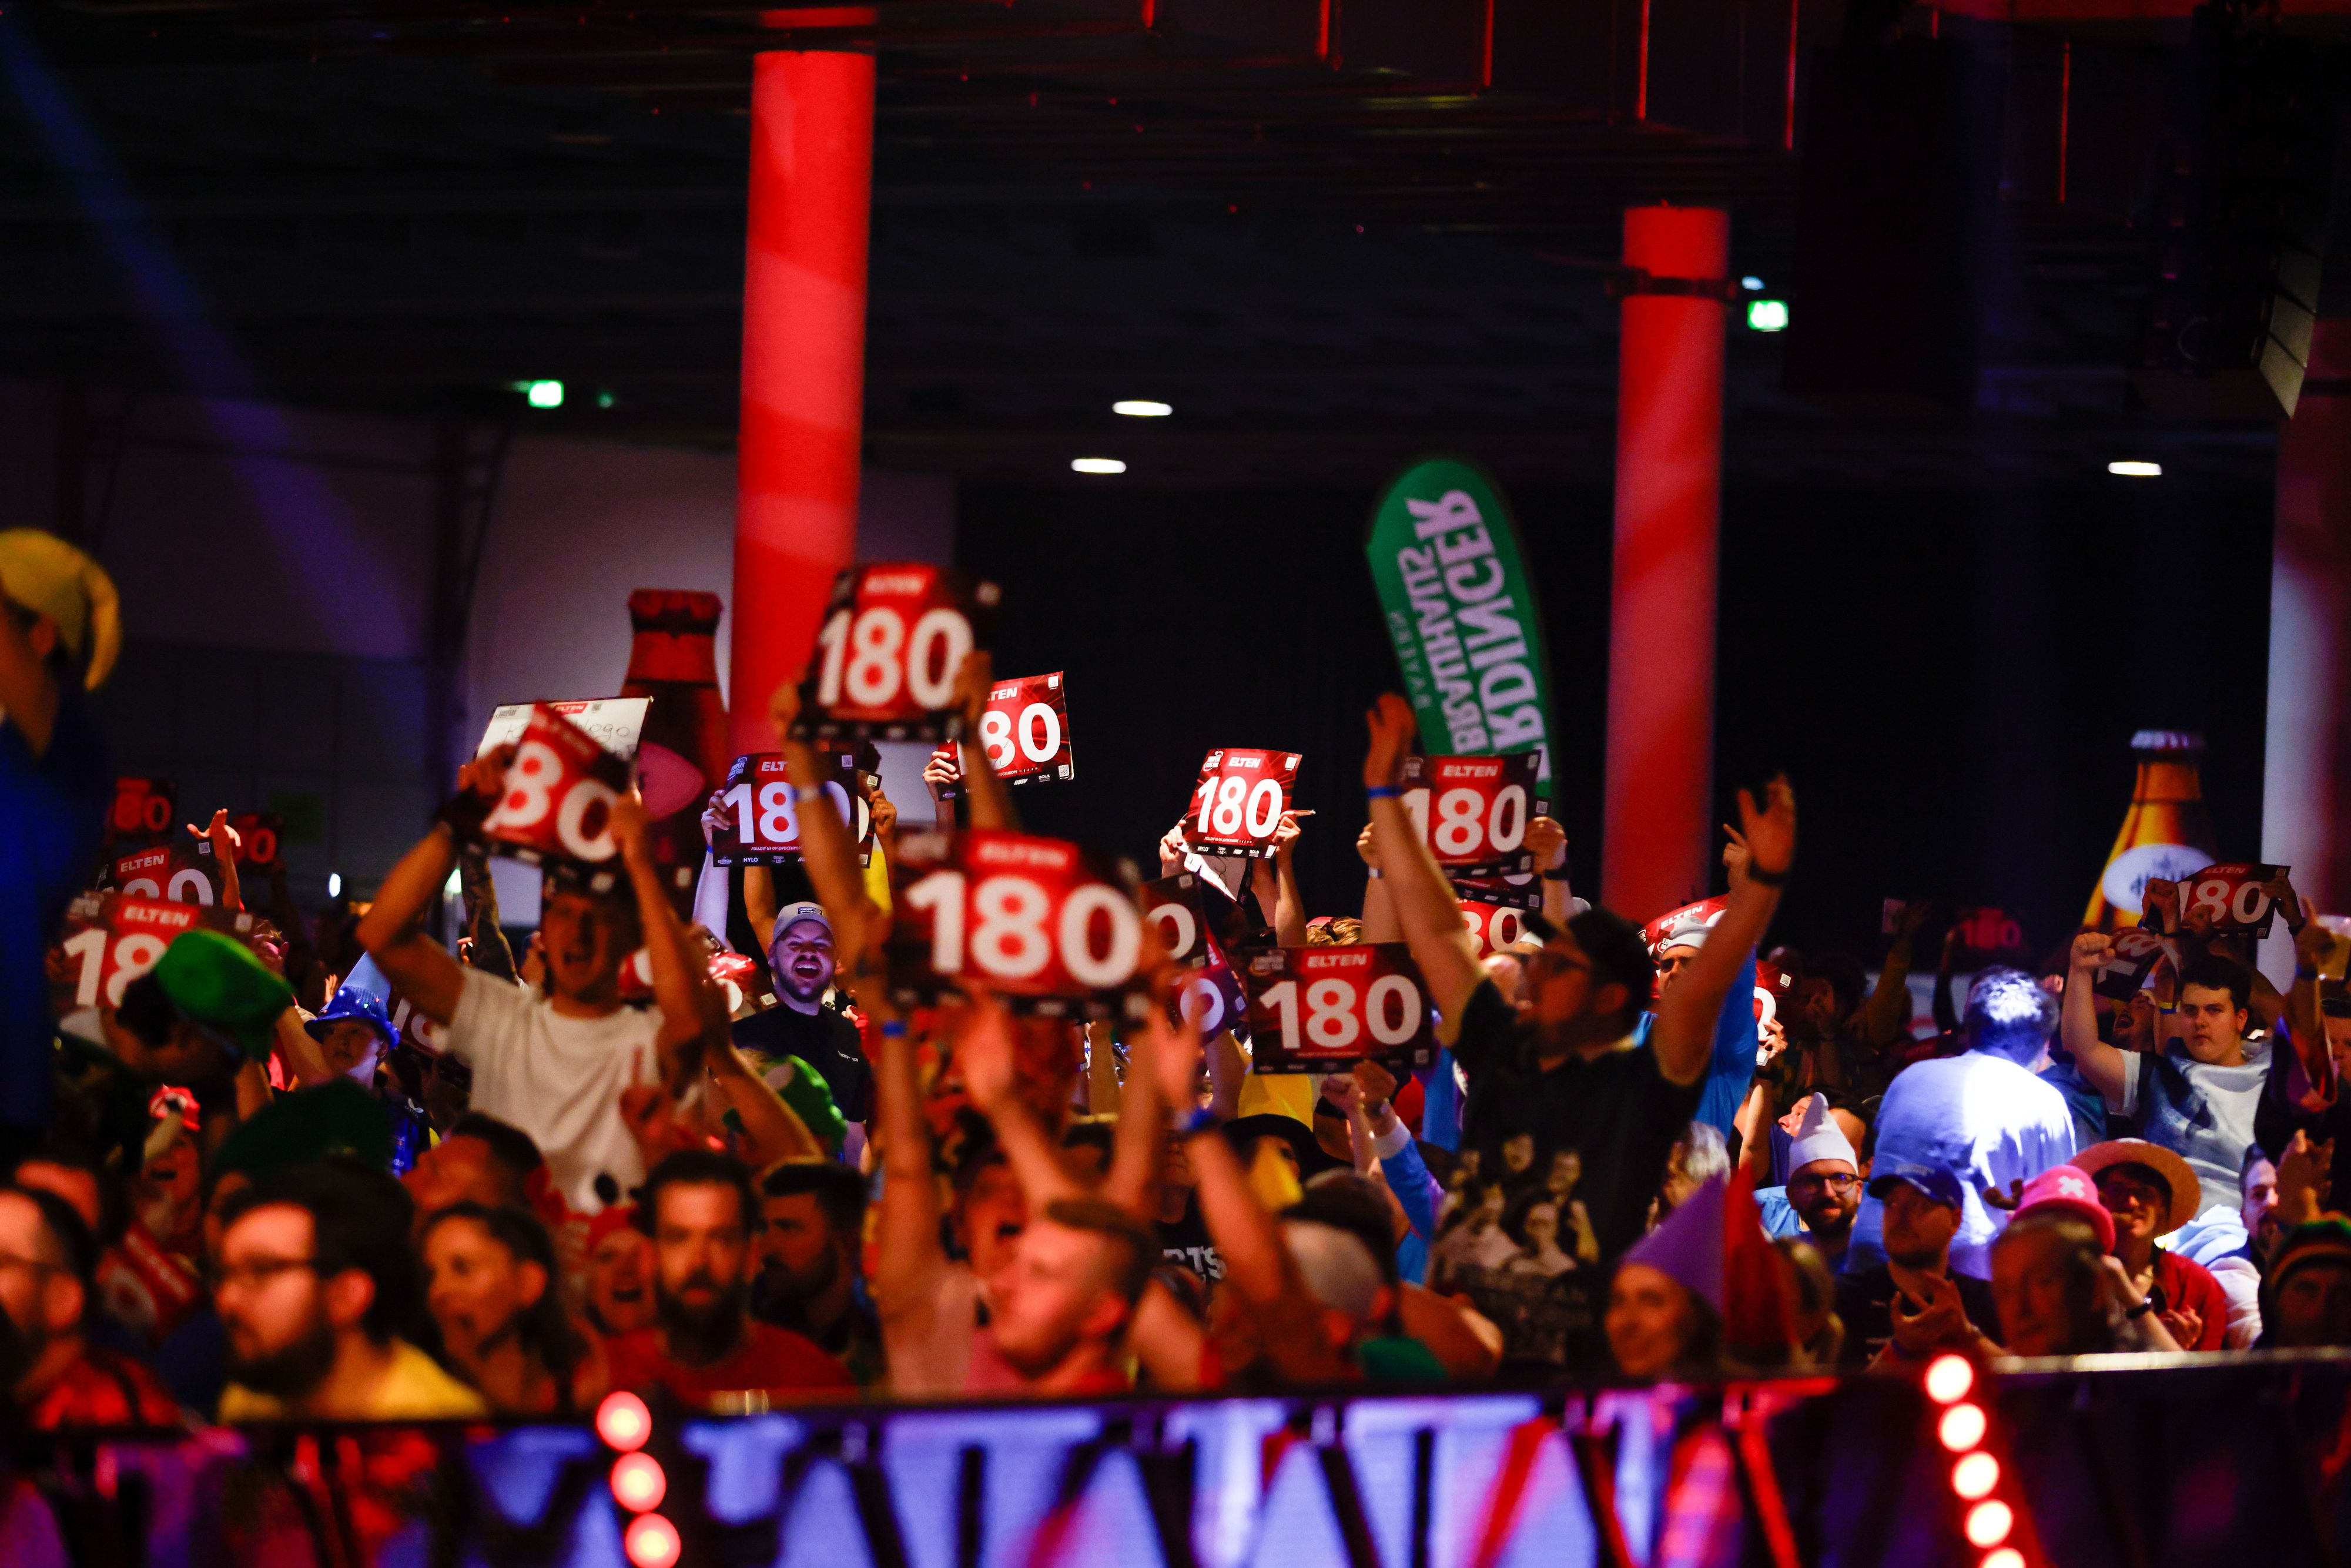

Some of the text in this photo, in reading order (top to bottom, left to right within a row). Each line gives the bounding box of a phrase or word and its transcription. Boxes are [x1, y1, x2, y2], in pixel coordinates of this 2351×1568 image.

[818, 607, 974, 709] 180
[987, 687, 1017, 701] TEN
[973, 702, 1061, 771] 80
[761, 760, 789, 772] ELT
[1228, 756, 1261, 769] ELTEN
[1442, 765, 1499, 778] ELTEN
[482, 741, 617, 857] 80
[1197, 775, 1283, 838] 180
[120, 854, 165, 873] ELTEN
[2204, 866, 2246, 875] ELTEN
[124, 906, 191, 927] ELTEN
[1660, 905, 1703, 929] ELTEN
[905, 870, 1141, 988] 180
[1460, 906, 1528, 955] 80
[63, 928, 167, 1008] 18
[1307, 953, 1367, 969] ELTEN
[1259, 974, 1422, 1050] 180
